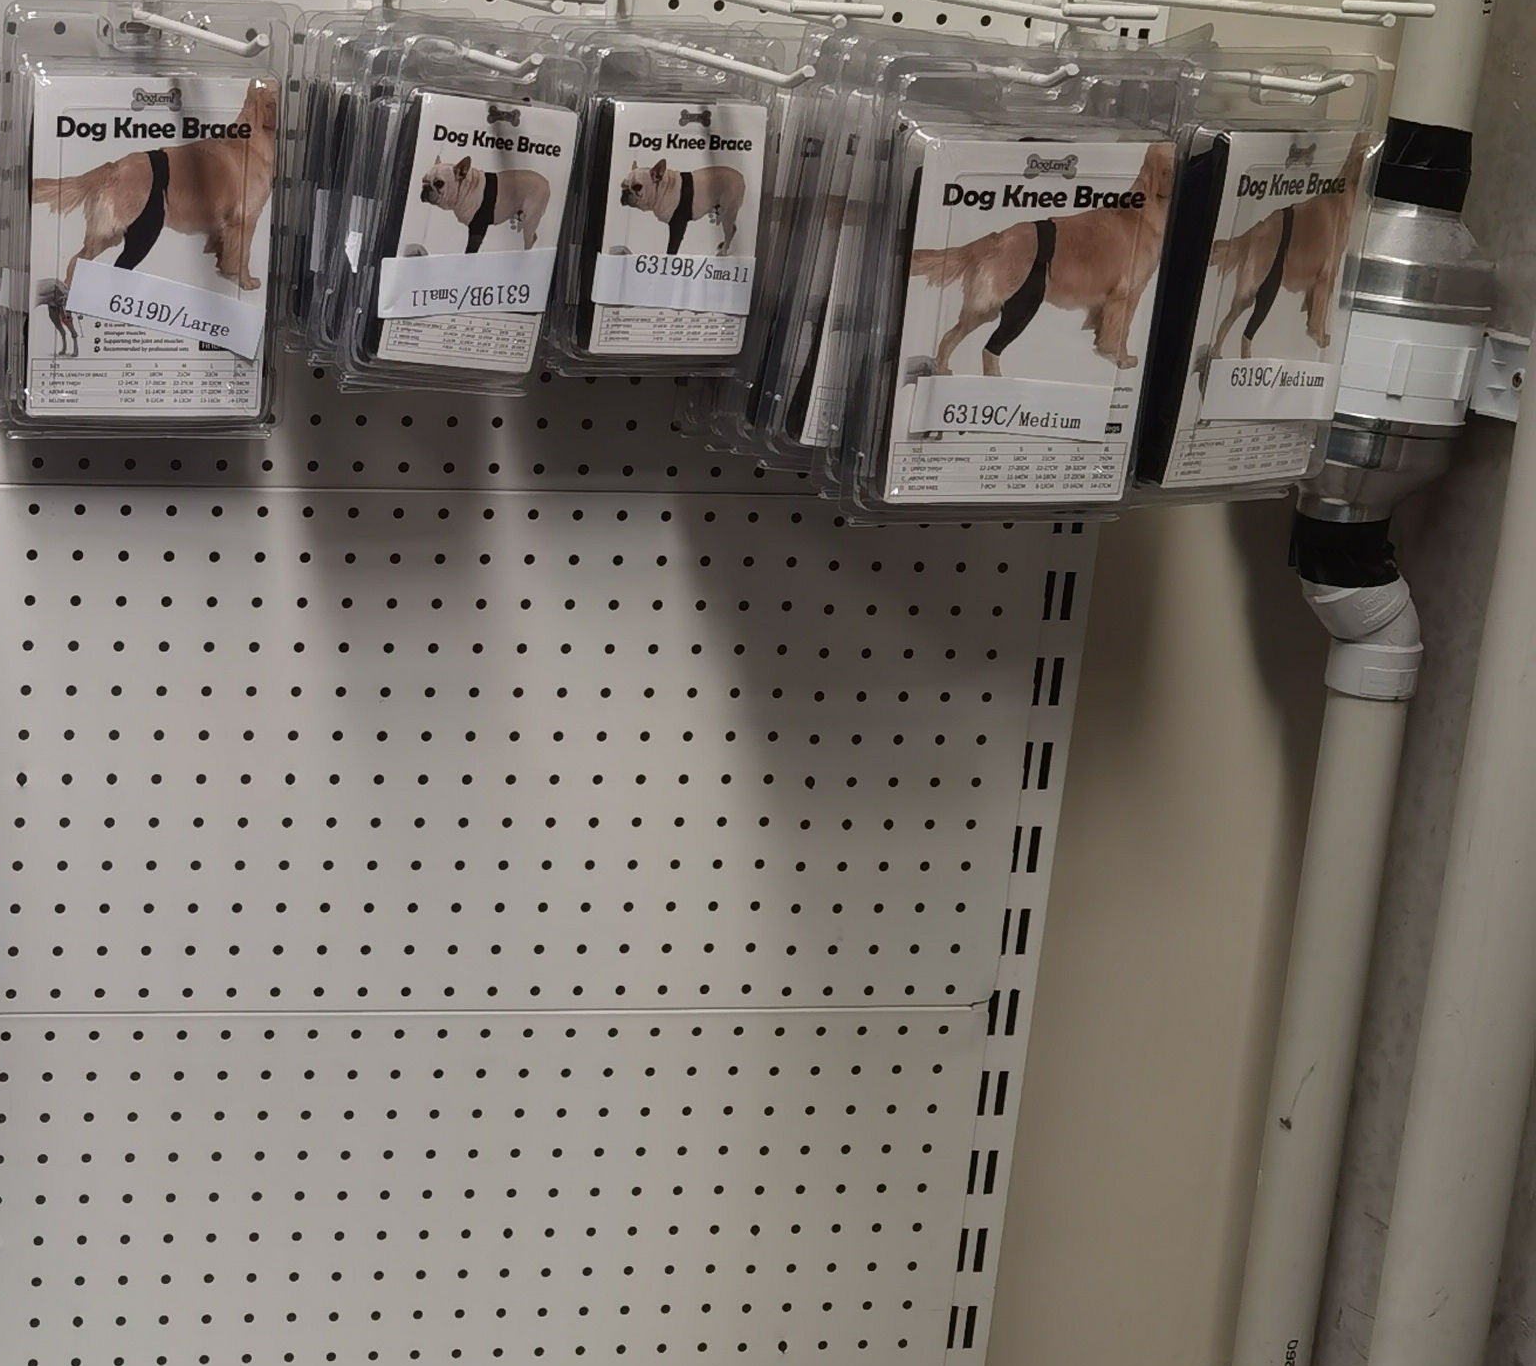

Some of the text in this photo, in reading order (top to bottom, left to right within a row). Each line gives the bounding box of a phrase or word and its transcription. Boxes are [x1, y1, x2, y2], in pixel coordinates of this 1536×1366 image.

[56, 116, 252, 141] Dog Knee Brace
[433, 124, 561, 157] Dog Knee Brace
[629, 132, 752, 151] Dog Knee Brace
[942, 184, 1146, 210] Dog Knee Brace
[1237, 173, 1345, 200] Dog Knee Brace
[635, 255, 748, 282] 6319B/Small
[109, 295, 230, 336] 6319D/Large
[1231, 365, 1324, 388] 6319C/Medium
[943, 404, 1081, 429] 6319C/Medium
